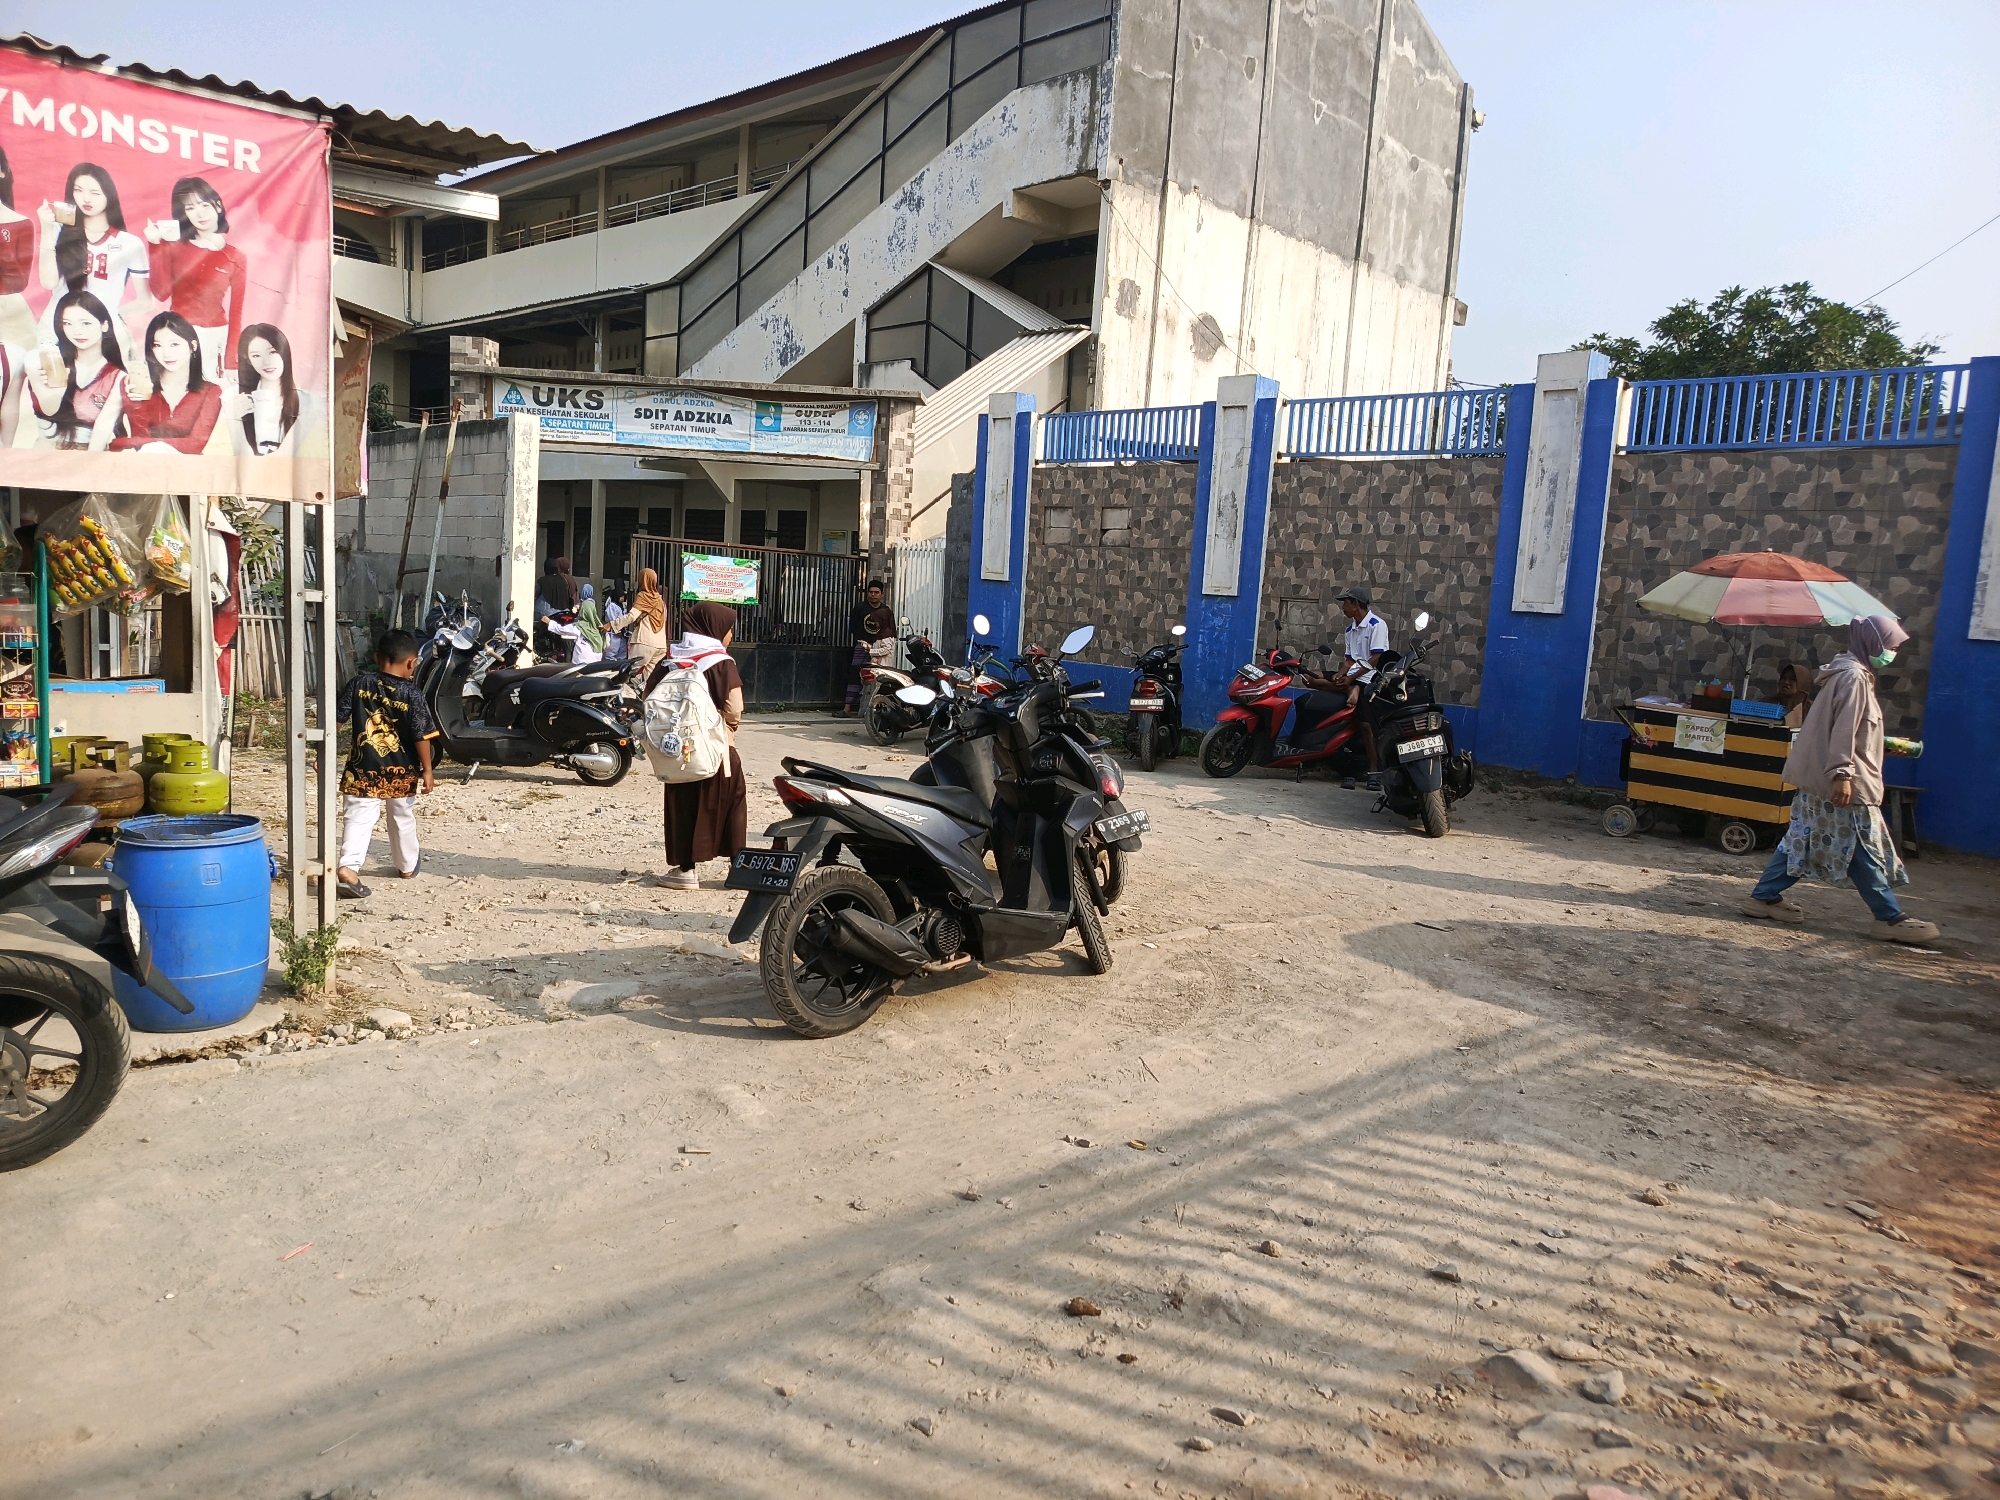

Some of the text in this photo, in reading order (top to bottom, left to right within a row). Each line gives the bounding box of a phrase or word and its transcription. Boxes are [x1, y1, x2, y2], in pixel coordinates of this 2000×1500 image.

[532, 386, 605, 410] UKS
[652, 397, 715, 408] DARUL ADZKIA
[498, 405, 610, 420] USAHA KESEHATAN SEKOLAH
[633, 407, 733, 426] SDIT ADZKIA
[794, 409, 837, 418] GUDEP
[549, 418, 583, 430] SEPATAN
[585, 421, 610, 431] TIMUR
[650, 422, 716, 435] SEPATAN TIMUR
[778, 435, 807, 445] ADZKIA
[809, 437, 845, 447] SEPATAN
[846, 438, 871, 448] TIMUR
[1685, 724, 1715, 734] PAPEDA
[1684, 733, 1714, 743] MARTEL
[665, 741, 677, 752] SIX
[1108, 816, 1130, 830] 2369
[735, 854, 745, 868] B
[750, 855, 775, 870] 6978
